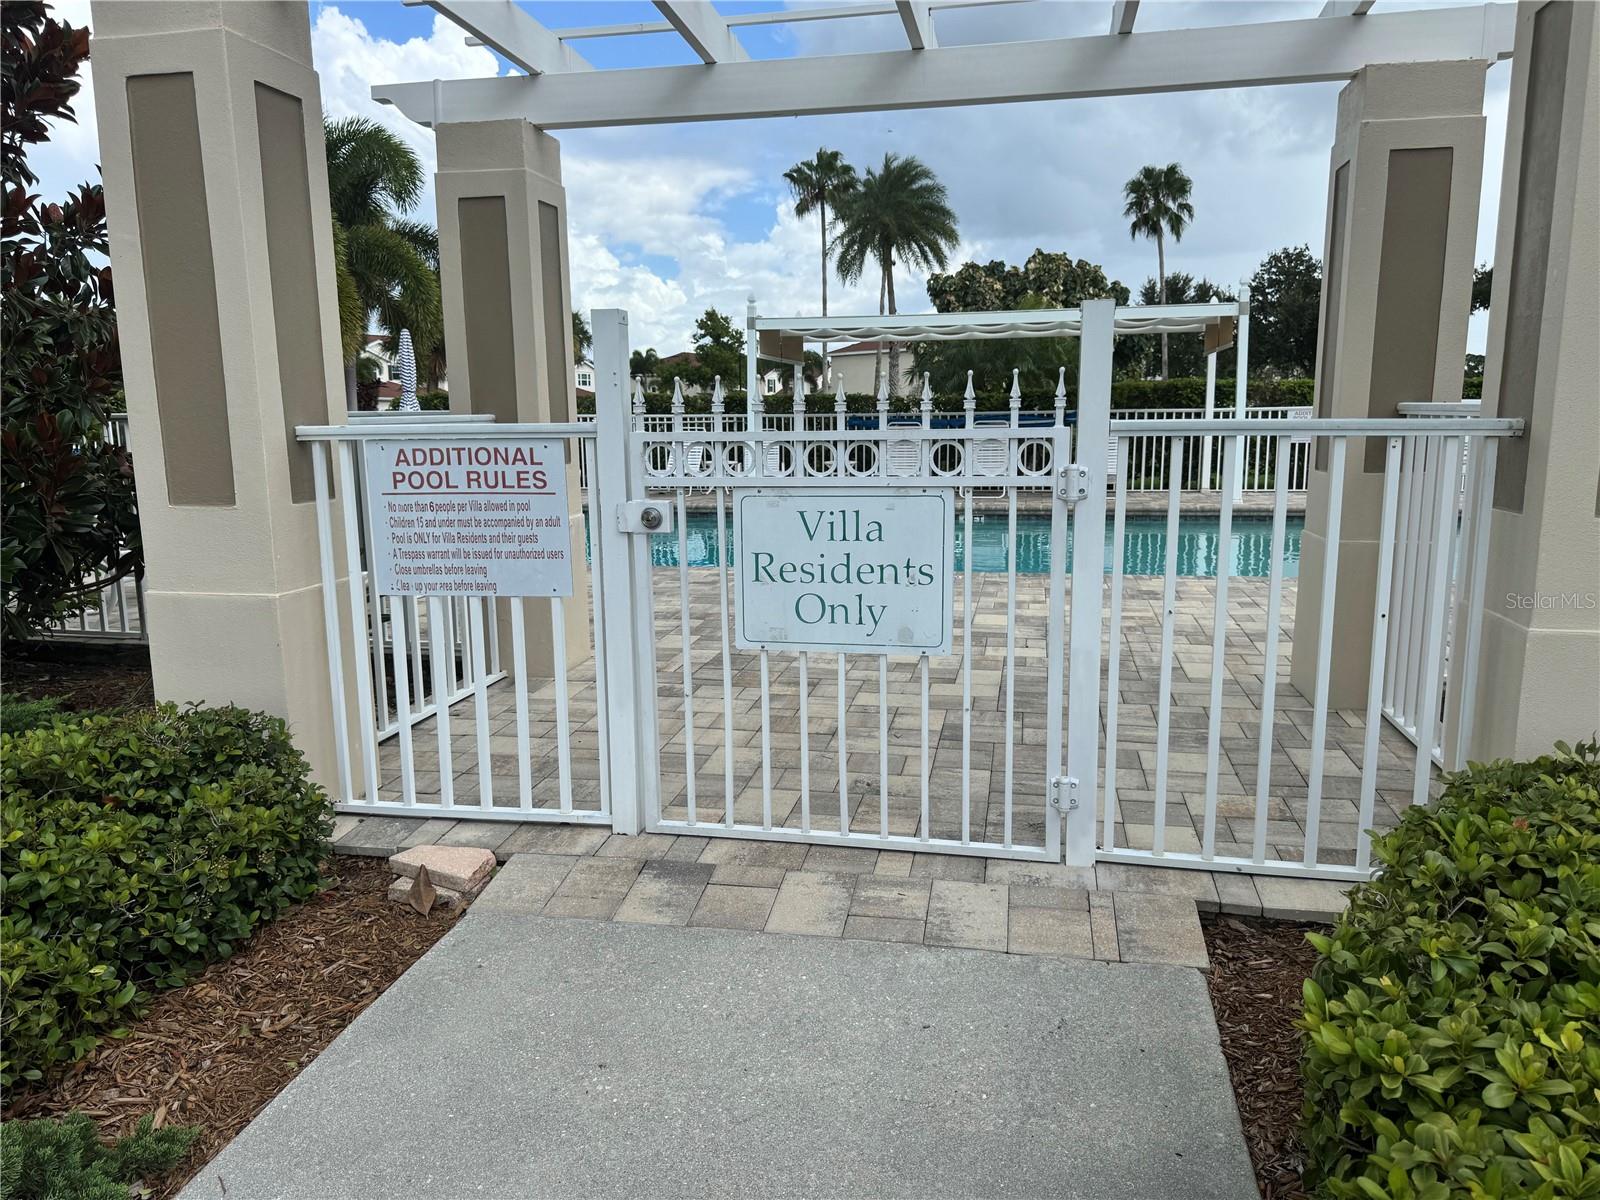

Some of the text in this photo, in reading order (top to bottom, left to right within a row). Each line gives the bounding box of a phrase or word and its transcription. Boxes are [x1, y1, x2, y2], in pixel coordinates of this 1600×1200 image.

[395, 447, 543, 466] ADDITIONAL
[392, 470, 547, 489] POOL RULES
[388, 500, 531, 514] No more than 6 people per Villa allowed in pool
[390, 516, 561, 530] Children 15 and under must be accompanied by an adult
[797, 509, 884, 542] Villa
[392, 532, 538, 546] Pool is ONLY for Villa Residents and their guests
[393, 548, 564, 562] A Trespass warrant will be issued for unauthorized users
[395, 563, 487, 577] Close umbrellas before leaving
[751, 552, 934, 585] Residents
[396, 579, 413, 591] Clea
[415, 582, 423, 593] up
[424, 582, 437, 594] your
[454, 579, 473, 591] before
[475, 579, 497, 594] leaving
[795, 593, 887, 637] Only
